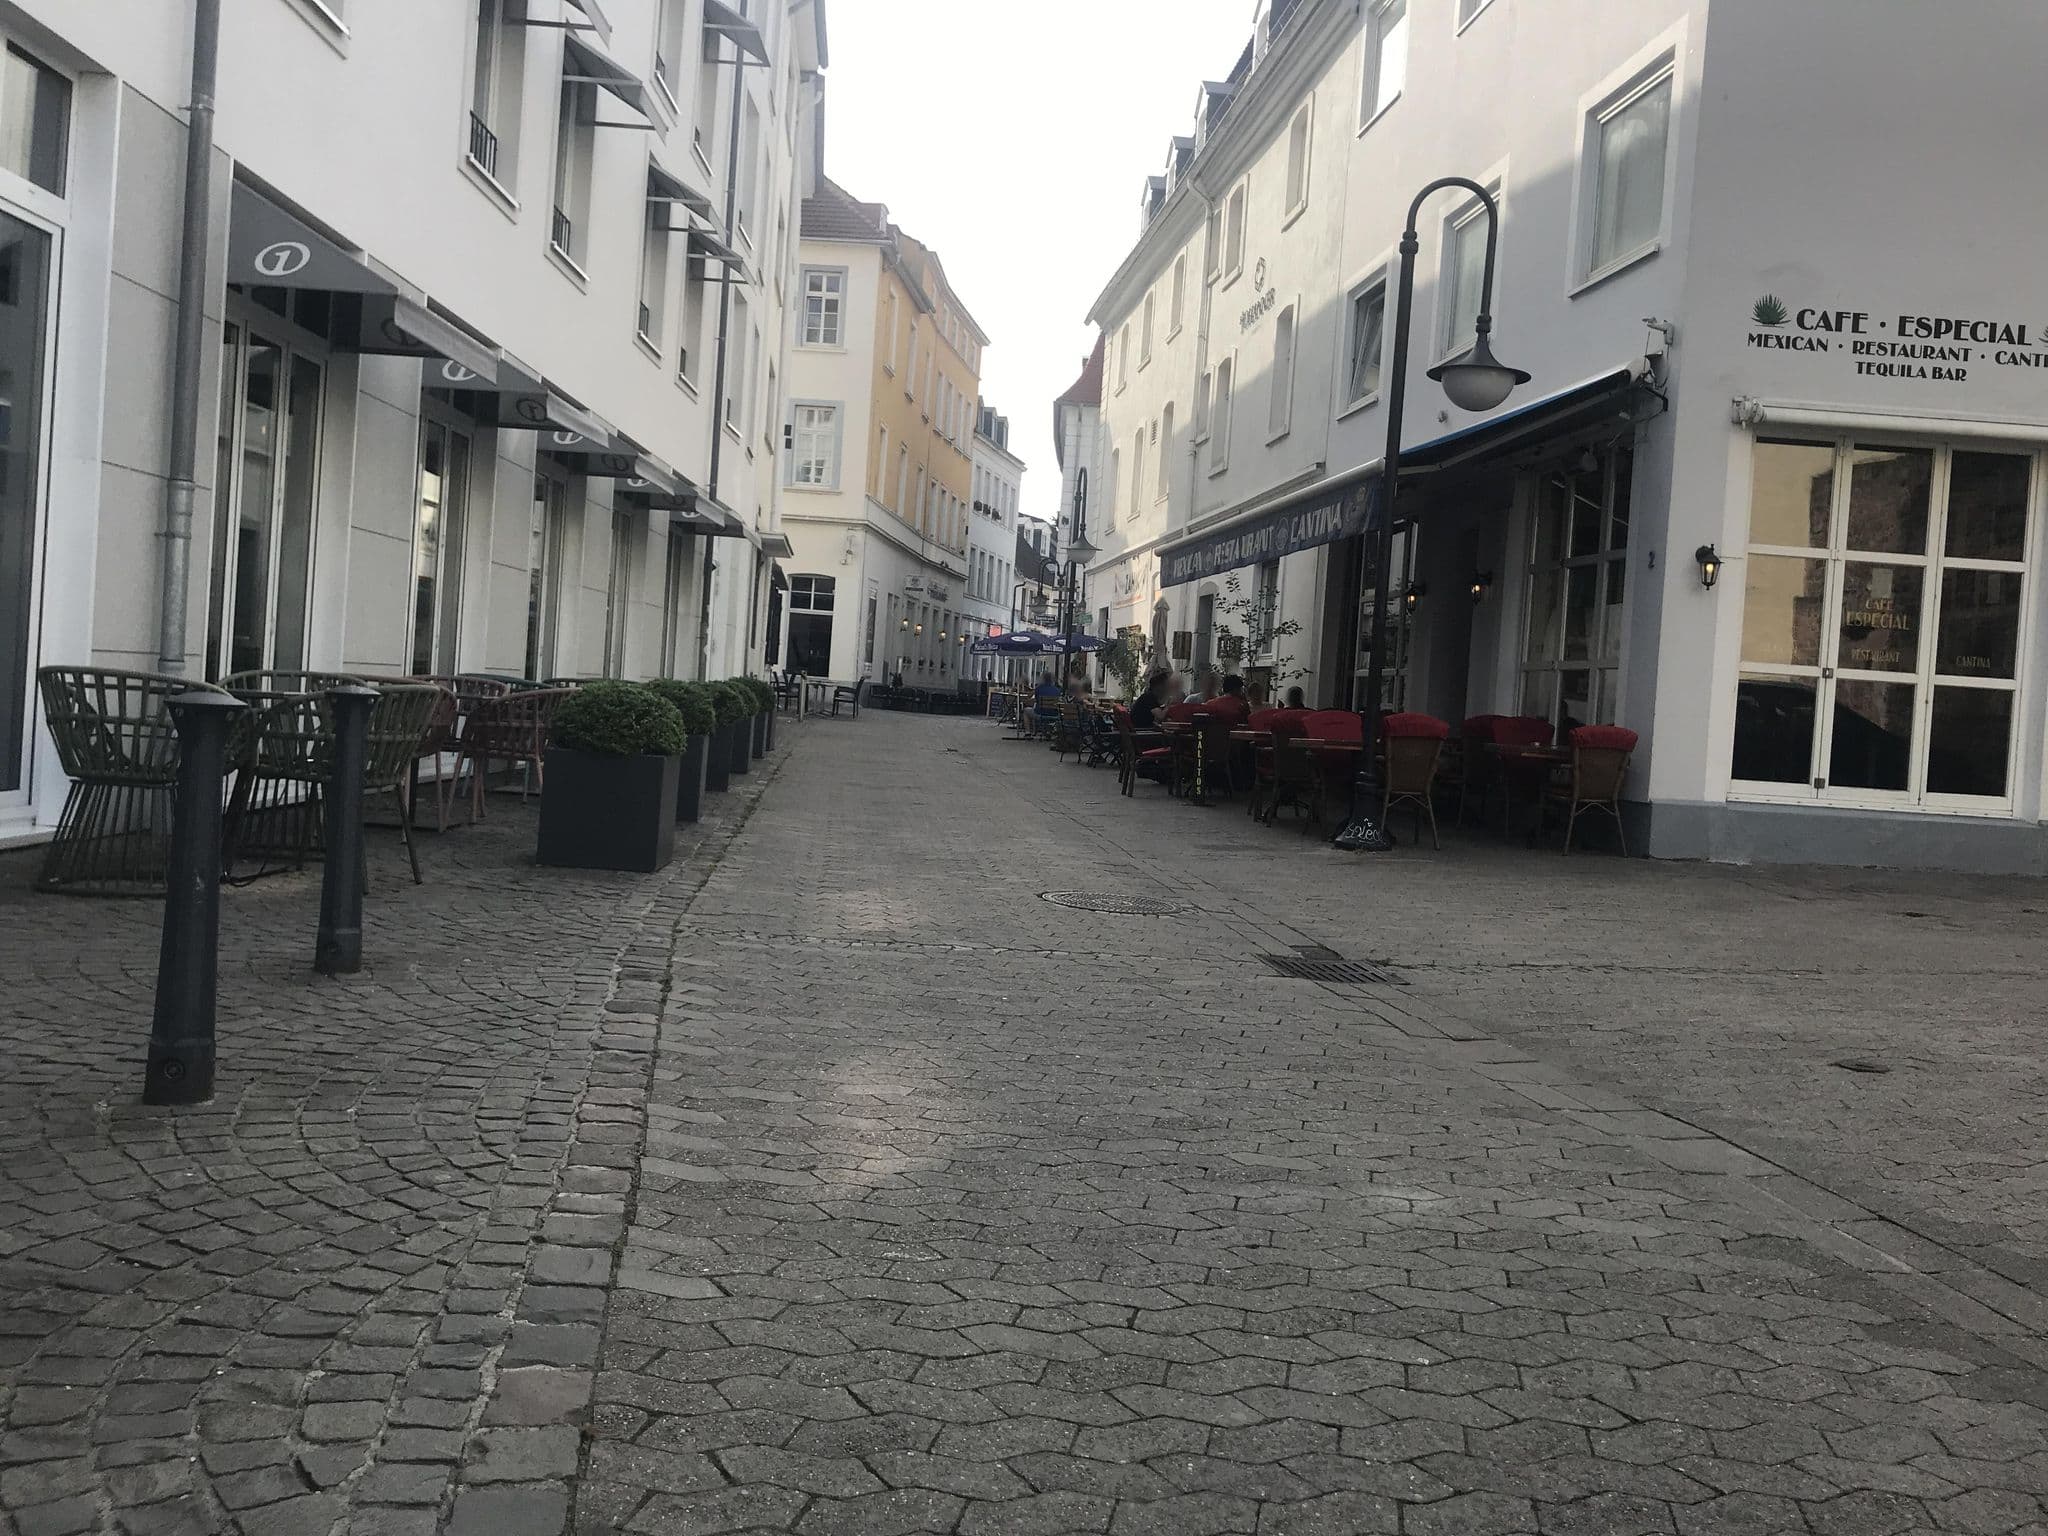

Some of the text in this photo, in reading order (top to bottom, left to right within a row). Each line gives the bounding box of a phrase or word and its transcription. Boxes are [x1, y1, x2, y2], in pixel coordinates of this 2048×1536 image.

[1796, 308, 2032, 346] CAFE ESPECIAL
[1747, 333, 1828, 352] MEXICAN
[1852, 340, 1972, 362] RESTAURANT
[1856, 361, 1967, 382] TEQUILA BAR
[1847, 612, 1909, 630] ESPECIAL
